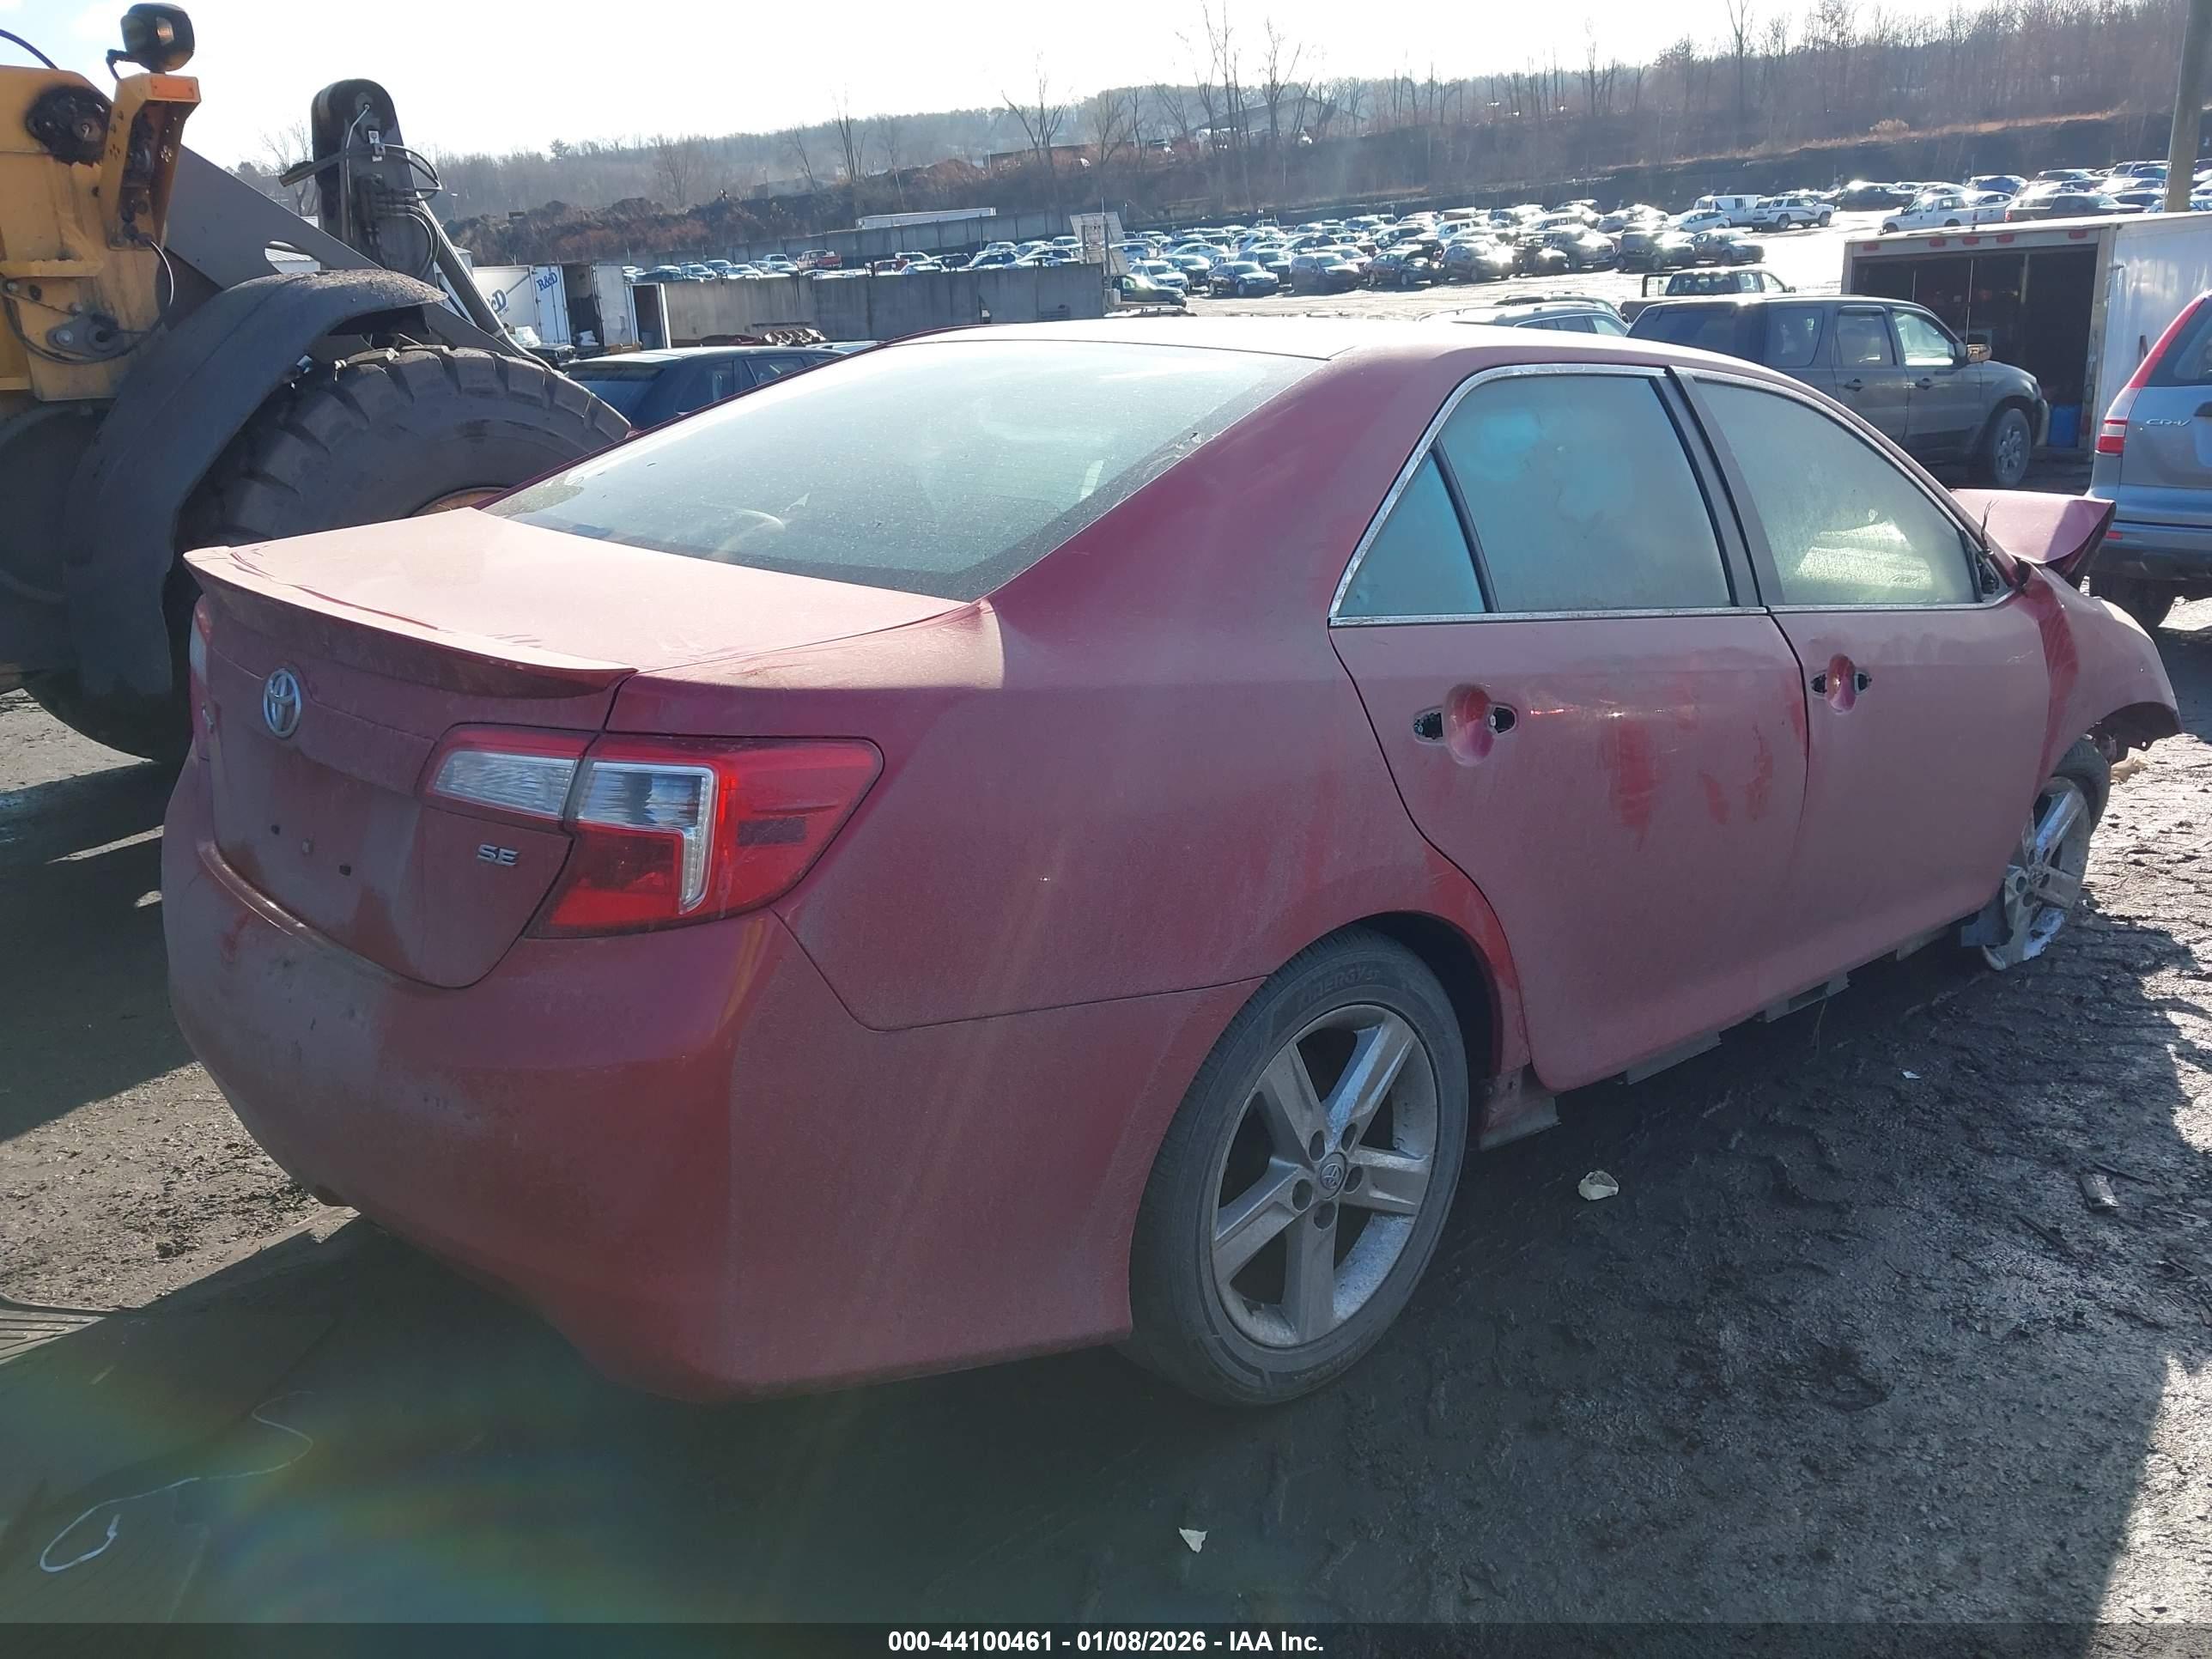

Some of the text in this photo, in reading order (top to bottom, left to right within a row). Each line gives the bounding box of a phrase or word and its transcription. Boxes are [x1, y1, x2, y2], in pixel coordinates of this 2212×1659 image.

[536, 272, 558, 291] R&D
[2146, 418, 2191, 427] CR-V
[477, 843, 520, 866] SE
